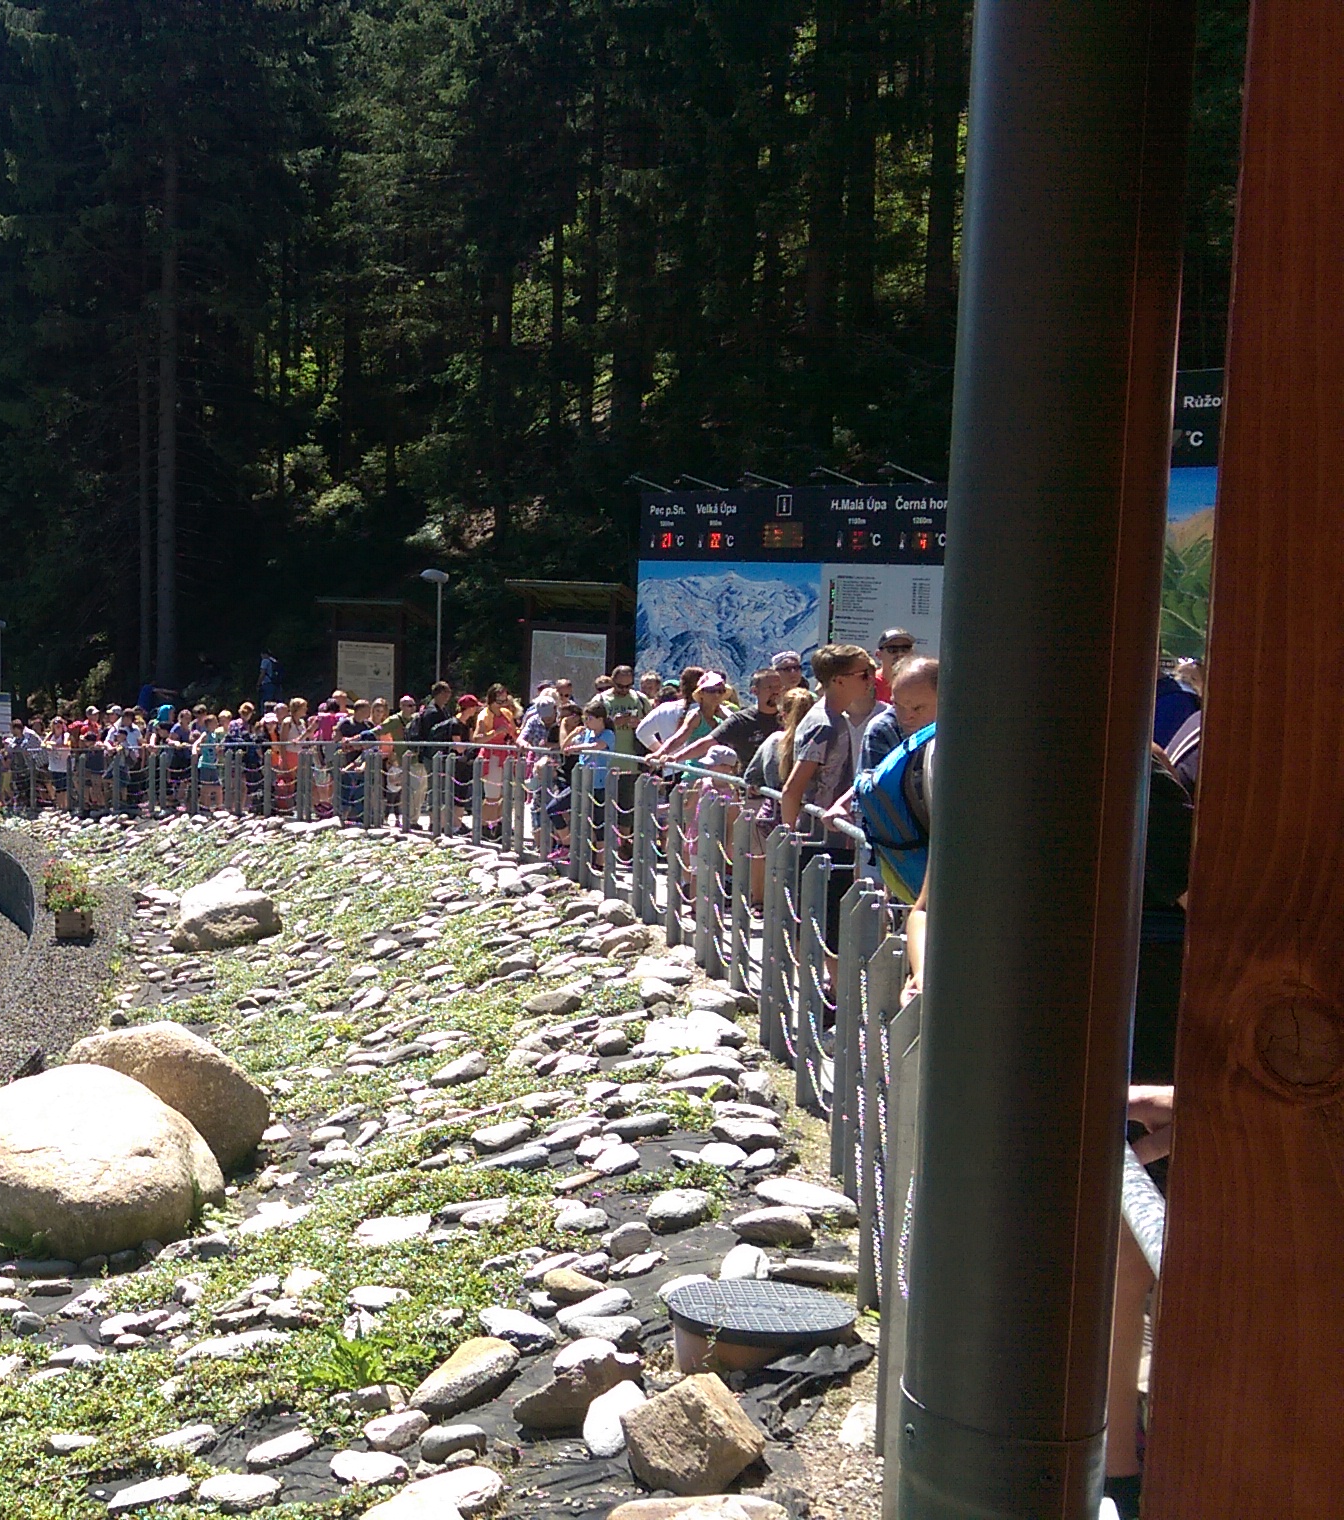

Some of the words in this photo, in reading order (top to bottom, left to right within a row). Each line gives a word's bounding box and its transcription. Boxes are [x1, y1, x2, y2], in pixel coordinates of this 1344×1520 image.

[1183, 394, 1224, 409] Růžo
[650, 505, 665, 515] Pec
[696, 503, 718, 514] Velká
[720, 501, 737, 516] Úpa
[867, 496, 887, 512] Úpa
[895, 495, 927, 510] Černá
